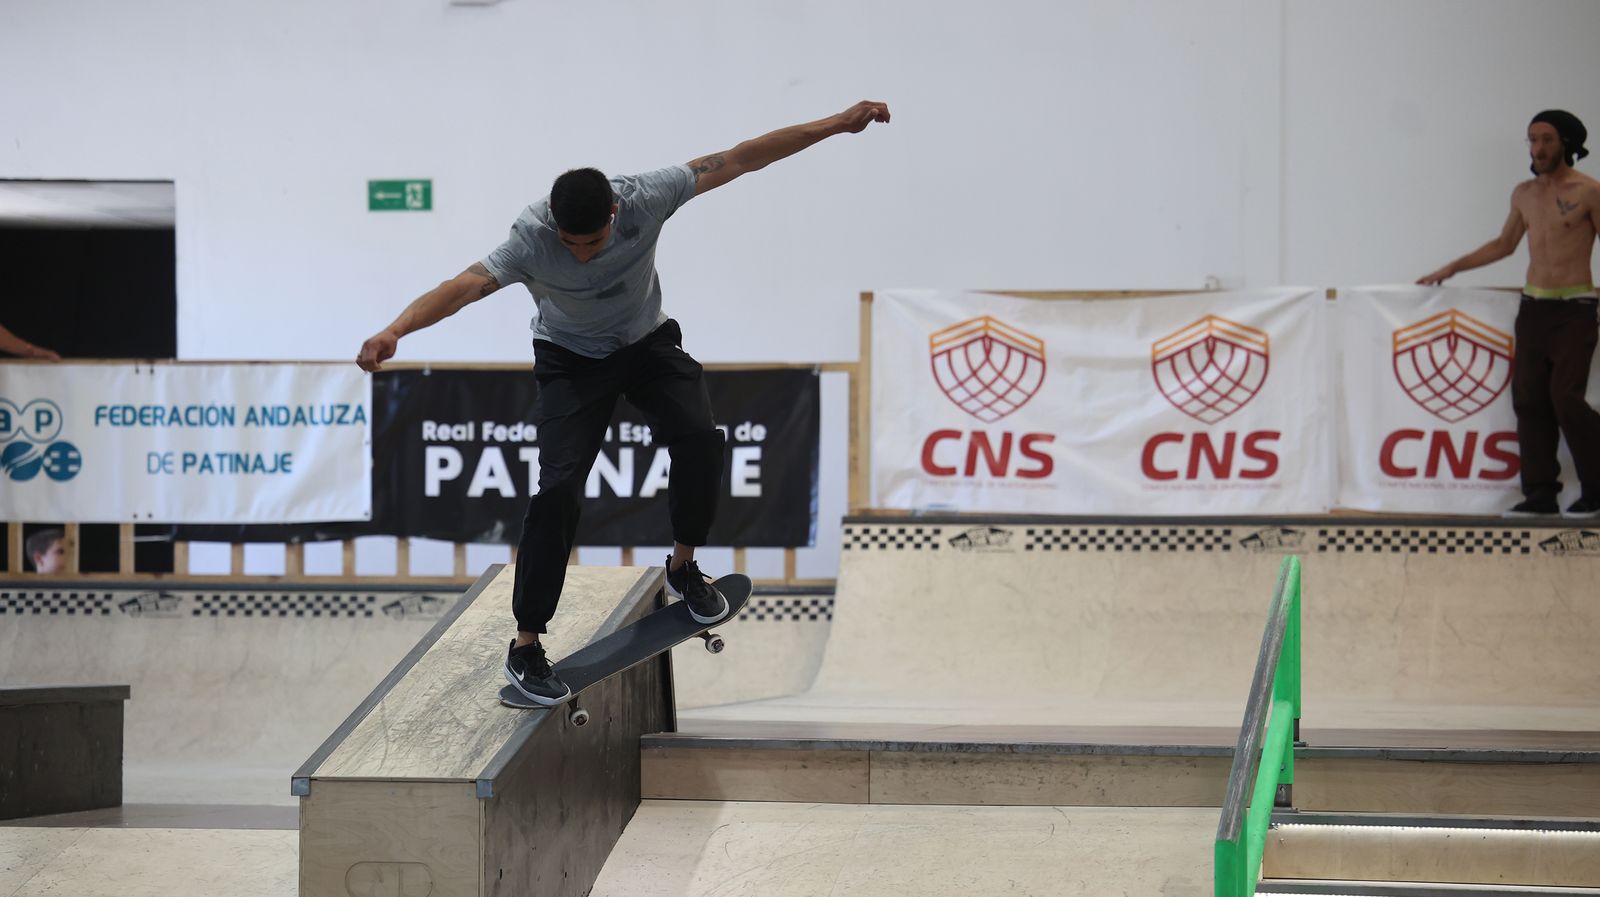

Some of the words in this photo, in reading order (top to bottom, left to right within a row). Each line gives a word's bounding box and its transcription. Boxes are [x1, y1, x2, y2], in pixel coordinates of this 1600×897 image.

[95, 401, 235, 427] FEDERACIÓN
[244, 404, 367, 426] ANDALUZA
[422, 420, 475, 442] Real
[734, 421, 767, 442] de
[147, 452, 175, 474] DE
[182, 452, 293, 475] PATINAJE
[424, 446, 763, 498] PATNAE
[921, 429, 1056, 478] CNS
[1141, 430, 1281, 480] CNS
[1379, 428, 1521, 481] CNS
